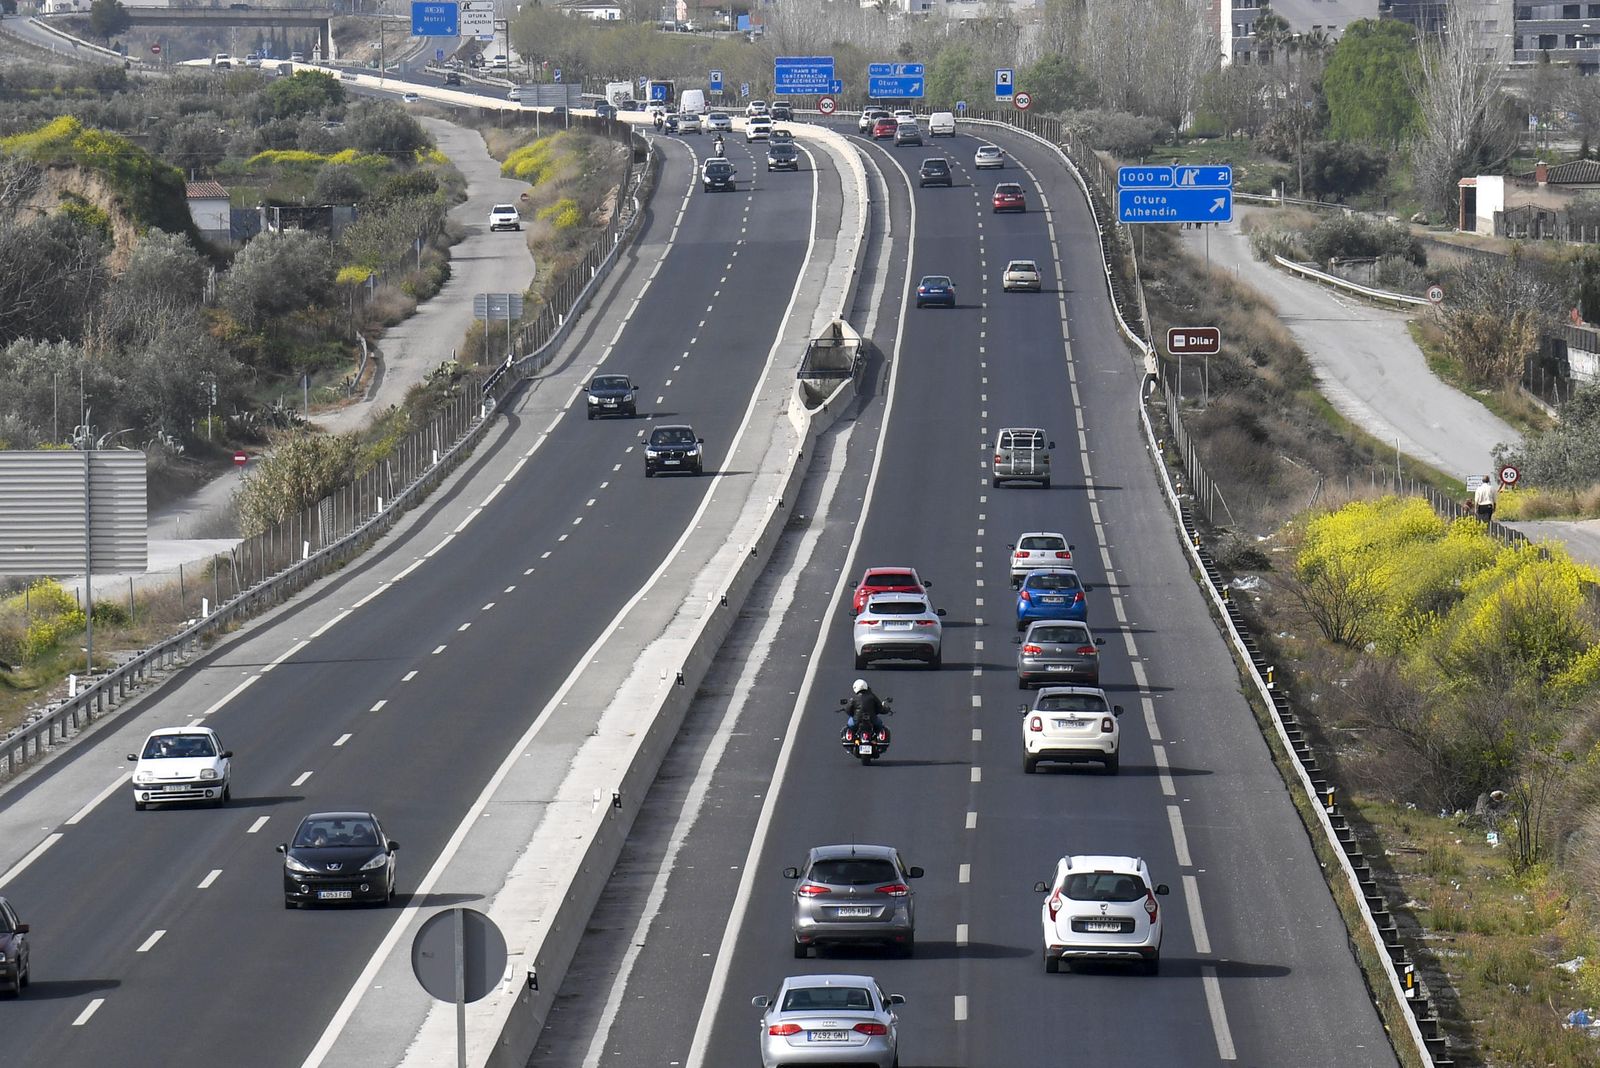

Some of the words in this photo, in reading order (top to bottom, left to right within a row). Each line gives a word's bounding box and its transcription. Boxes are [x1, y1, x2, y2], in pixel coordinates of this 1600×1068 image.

[1122, 173, 1154, 182] 1000
[1218, 172, 1228, 180] 21
[1134, 196, 1167, 204] Otura
